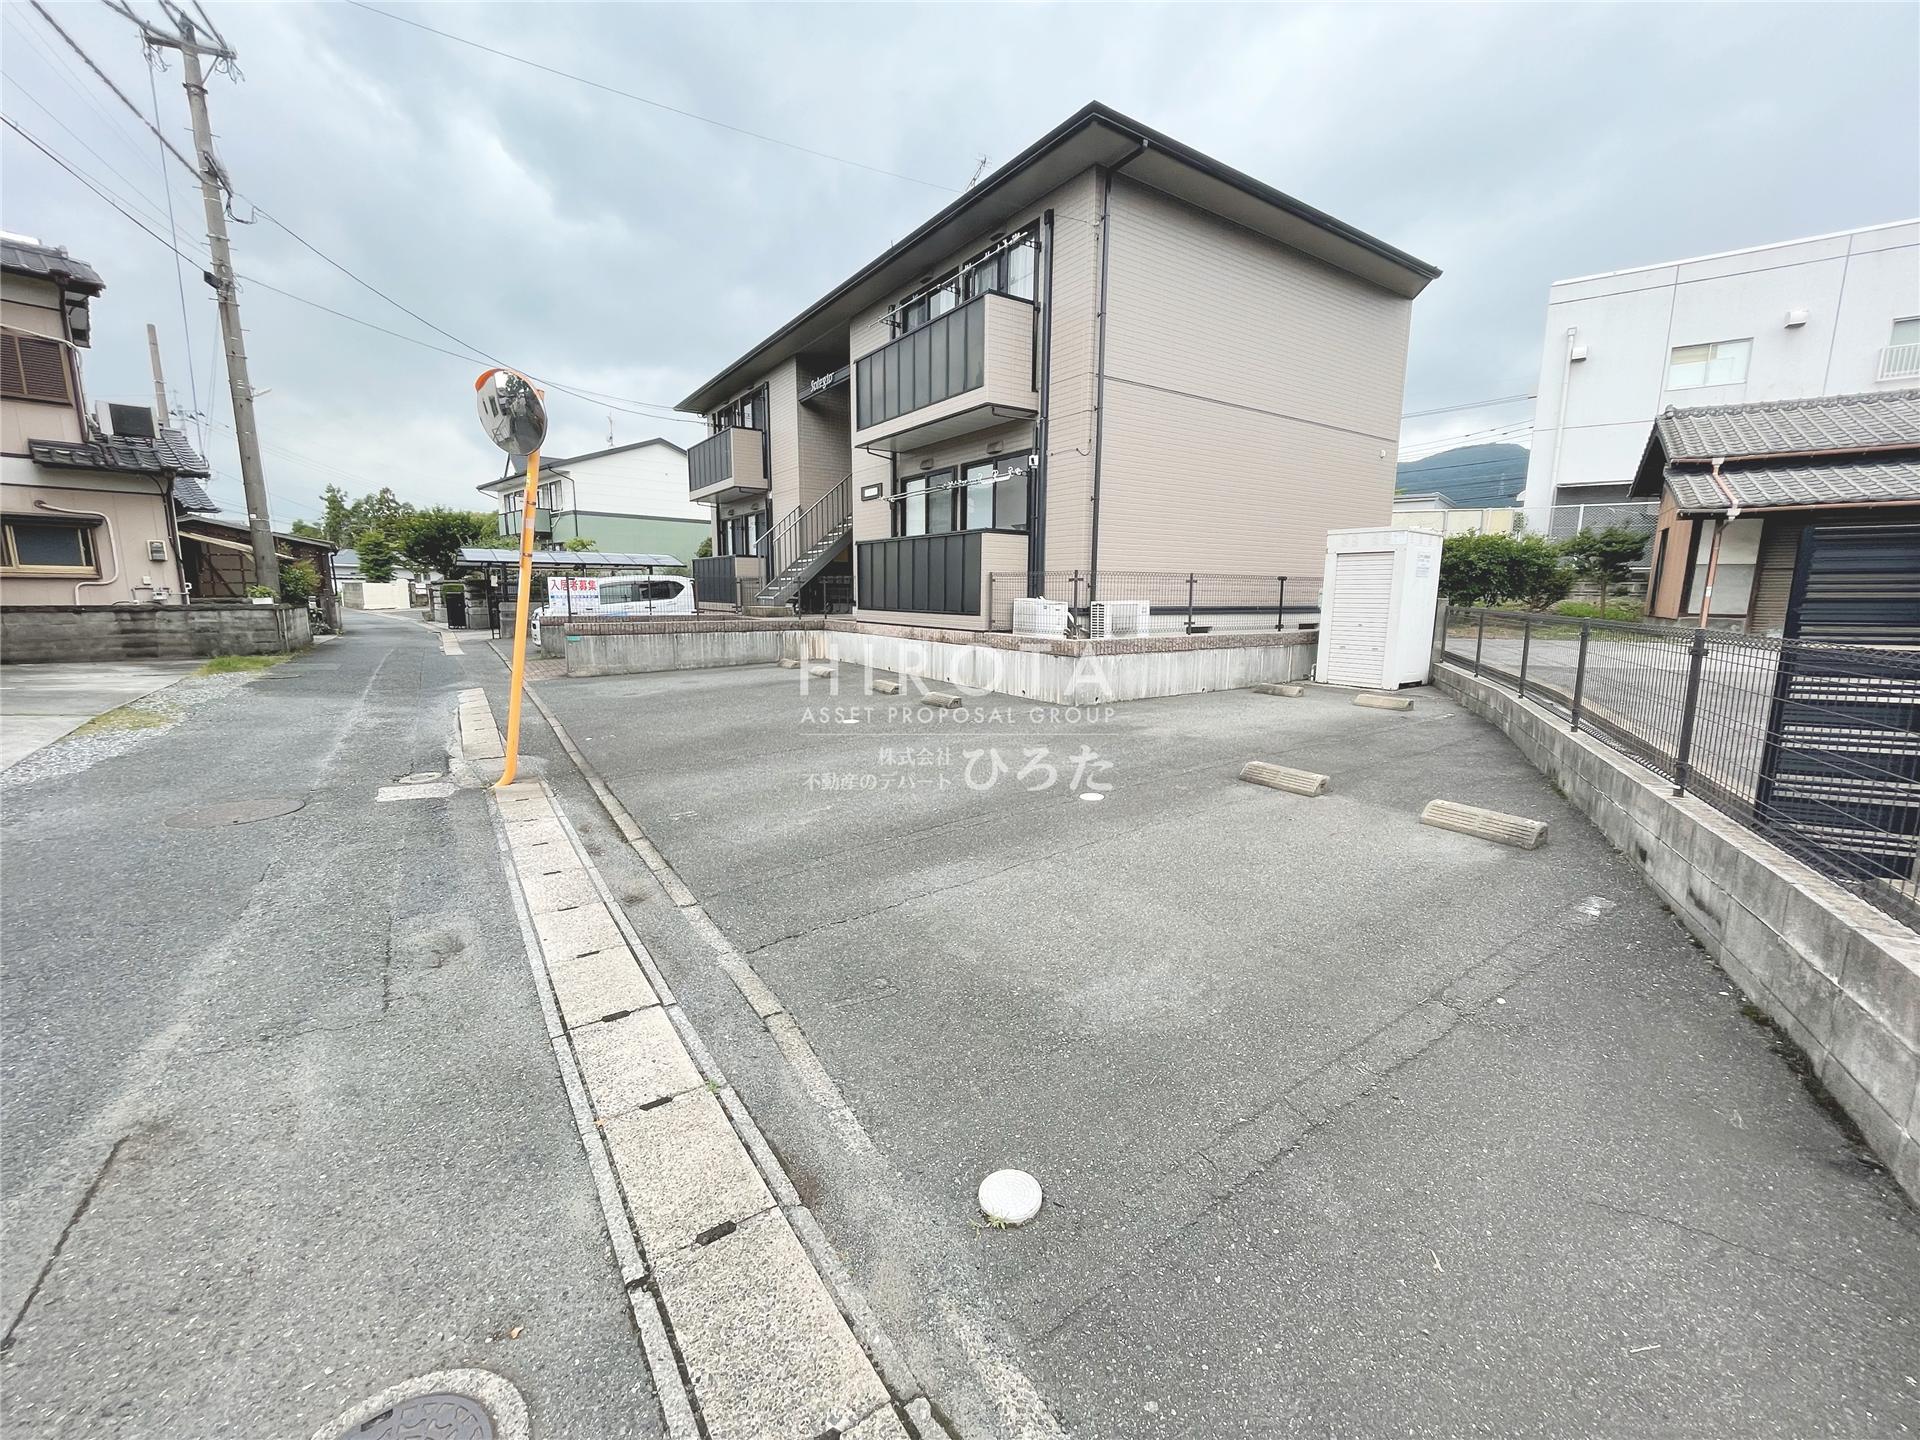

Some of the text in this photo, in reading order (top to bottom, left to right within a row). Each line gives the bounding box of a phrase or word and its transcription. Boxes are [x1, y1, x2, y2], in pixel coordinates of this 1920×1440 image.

[551, 579, 597, 591] 入居者募集
